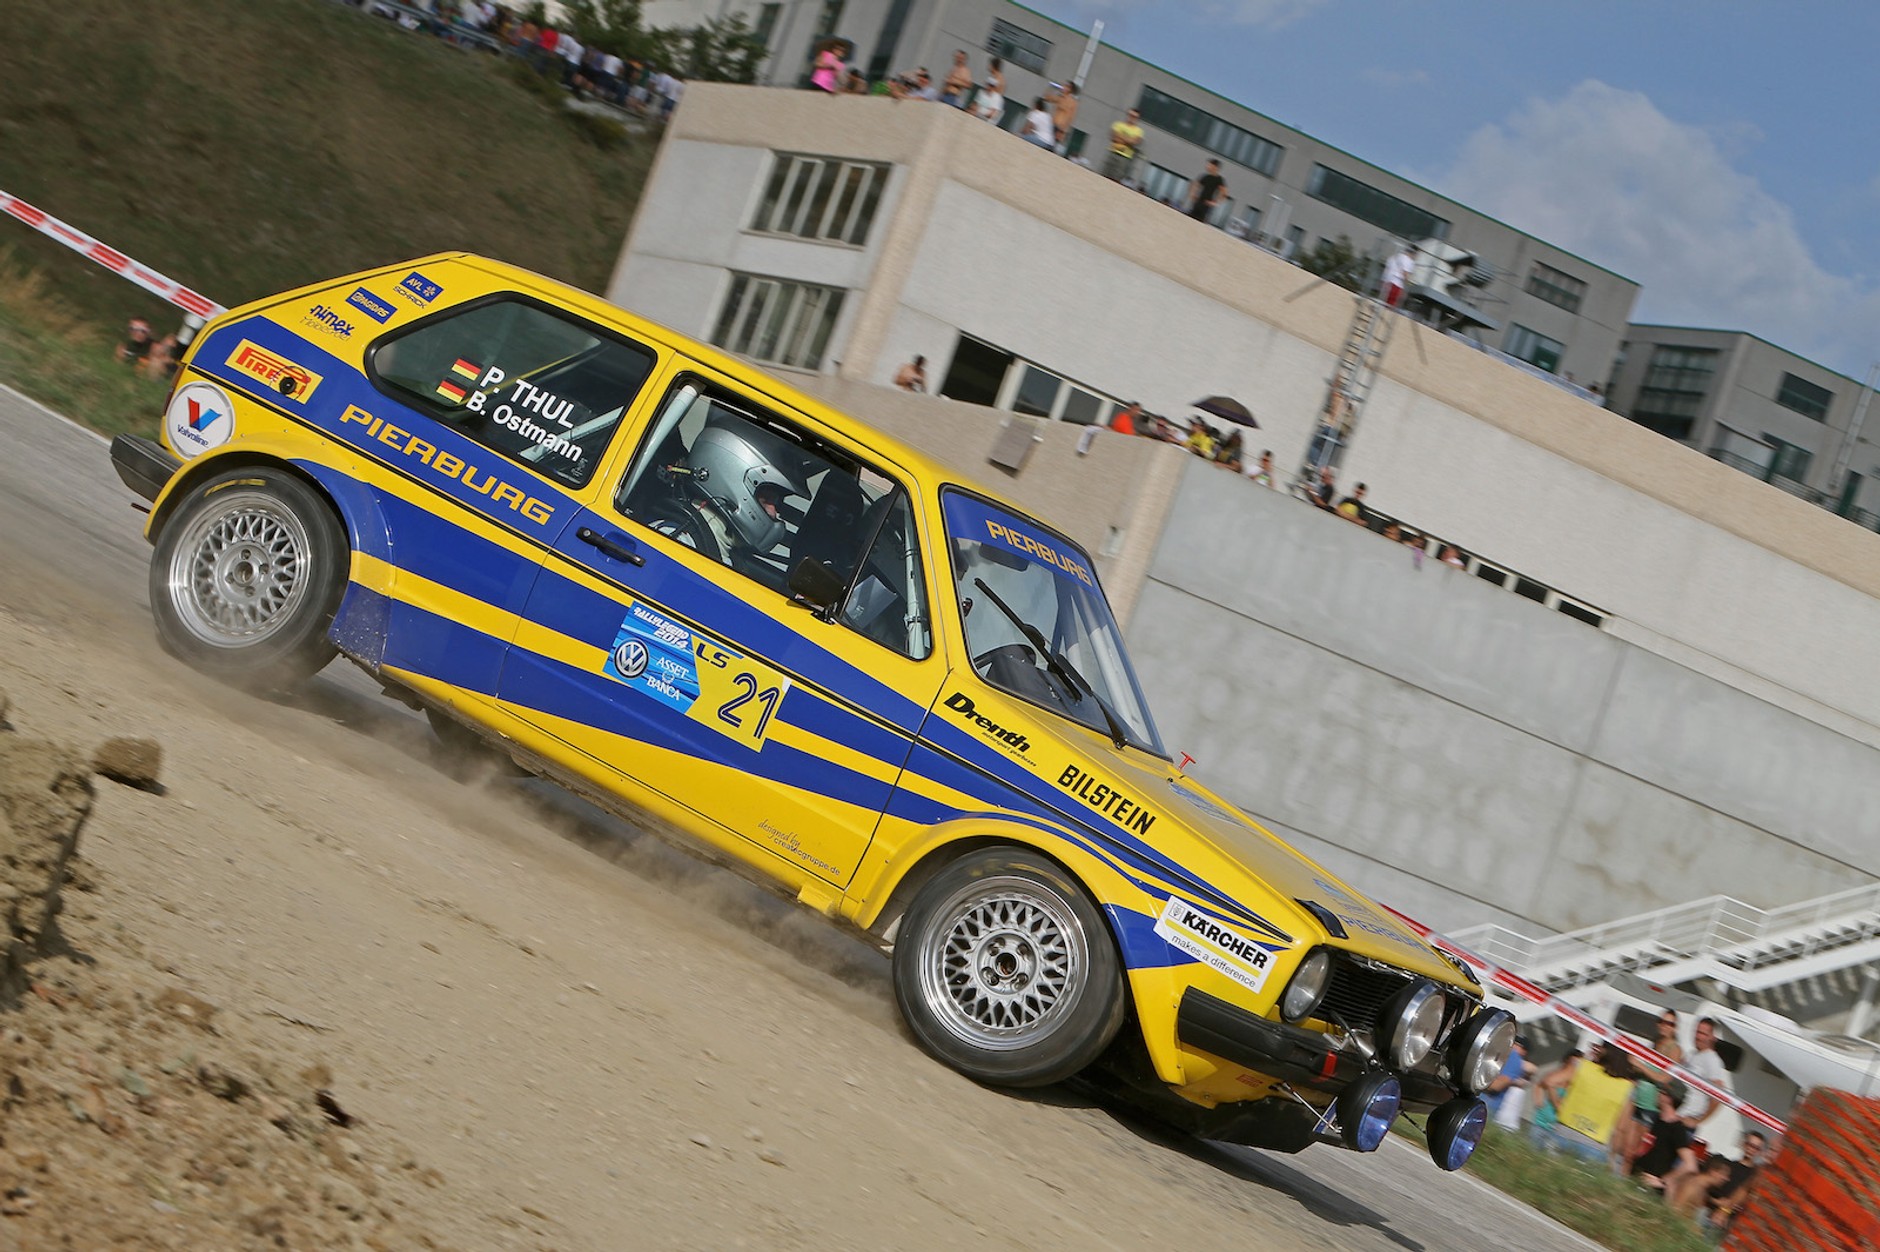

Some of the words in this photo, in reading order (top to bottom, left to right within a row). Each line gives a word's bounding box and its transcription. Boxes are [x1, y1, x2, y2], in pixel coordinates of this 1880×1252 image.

[406, 278, 423, 291] AVL
[310, 304, 355, 336] nimex
[236, 346, 312, 396] PIREI
[480, 366, 505, 394] P.
[510, 379, 574, 429] THUL
[177, 424, 209, 447] Valvoline
[466, 390, 486, 416] B.
[492, 405, 582, 461] Ostmann
[339, 403, 555, 526] PIERBURG
[985, 519, 1093, 587] PIERBURG
[654, 628, 689, 650] 2014
[696, 643, 730, 668] LS
[646, 676, 680, 701] BANCA
[656, 657, 689, 679] ASSET
[717, 672, 780, 739] 21
[944, 692, 1031, 752] Drenth
[1057, 764, 1157, 836] BILSTEIN
[1171, 935, 1201, 956] makes
[1202, 952, 1210, 962] a
[1211, 957, 1256, 988] difference
[1181, 910, 1268, 969] KÄRCHER
